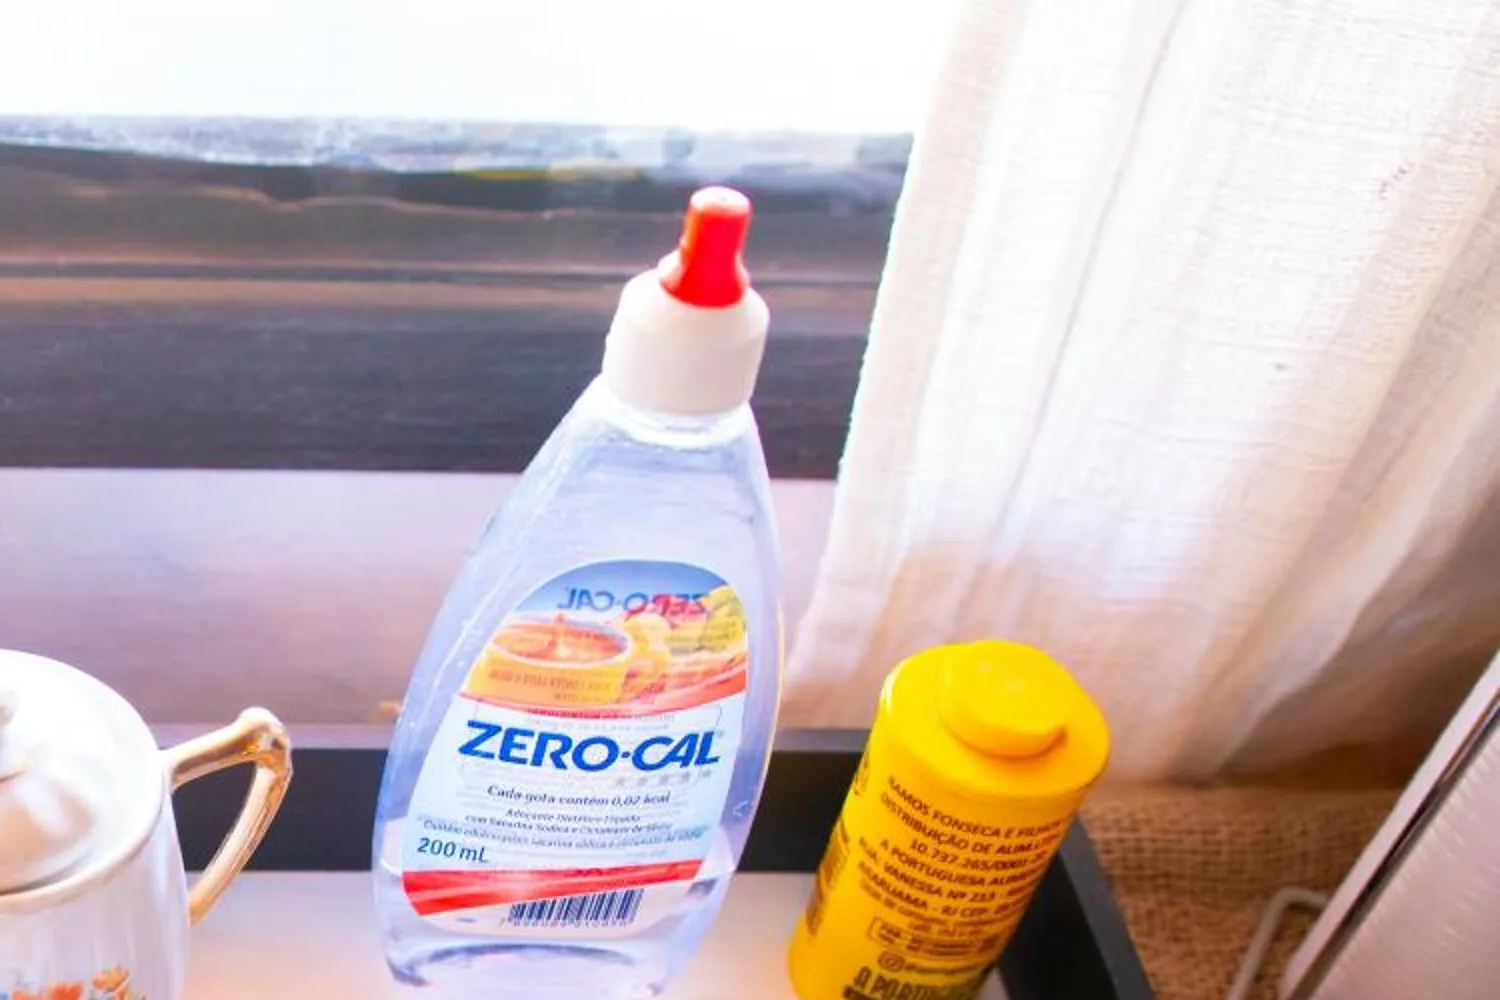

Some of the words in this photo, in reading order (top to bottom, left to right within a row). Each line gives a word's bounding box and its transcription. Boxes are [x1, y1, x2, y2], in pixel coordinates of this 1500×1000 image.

[487, 784, 522, 801] Cada
[524, 792, 556, 806] gota
[643, 789, 672, 804] kcal
[417, 837, 456, 858] 200
[459, 845, 490, 864] mL
[882, 861, 942, 898] VANESSA
[891, 847, 986, 887] PORTUGUESA
